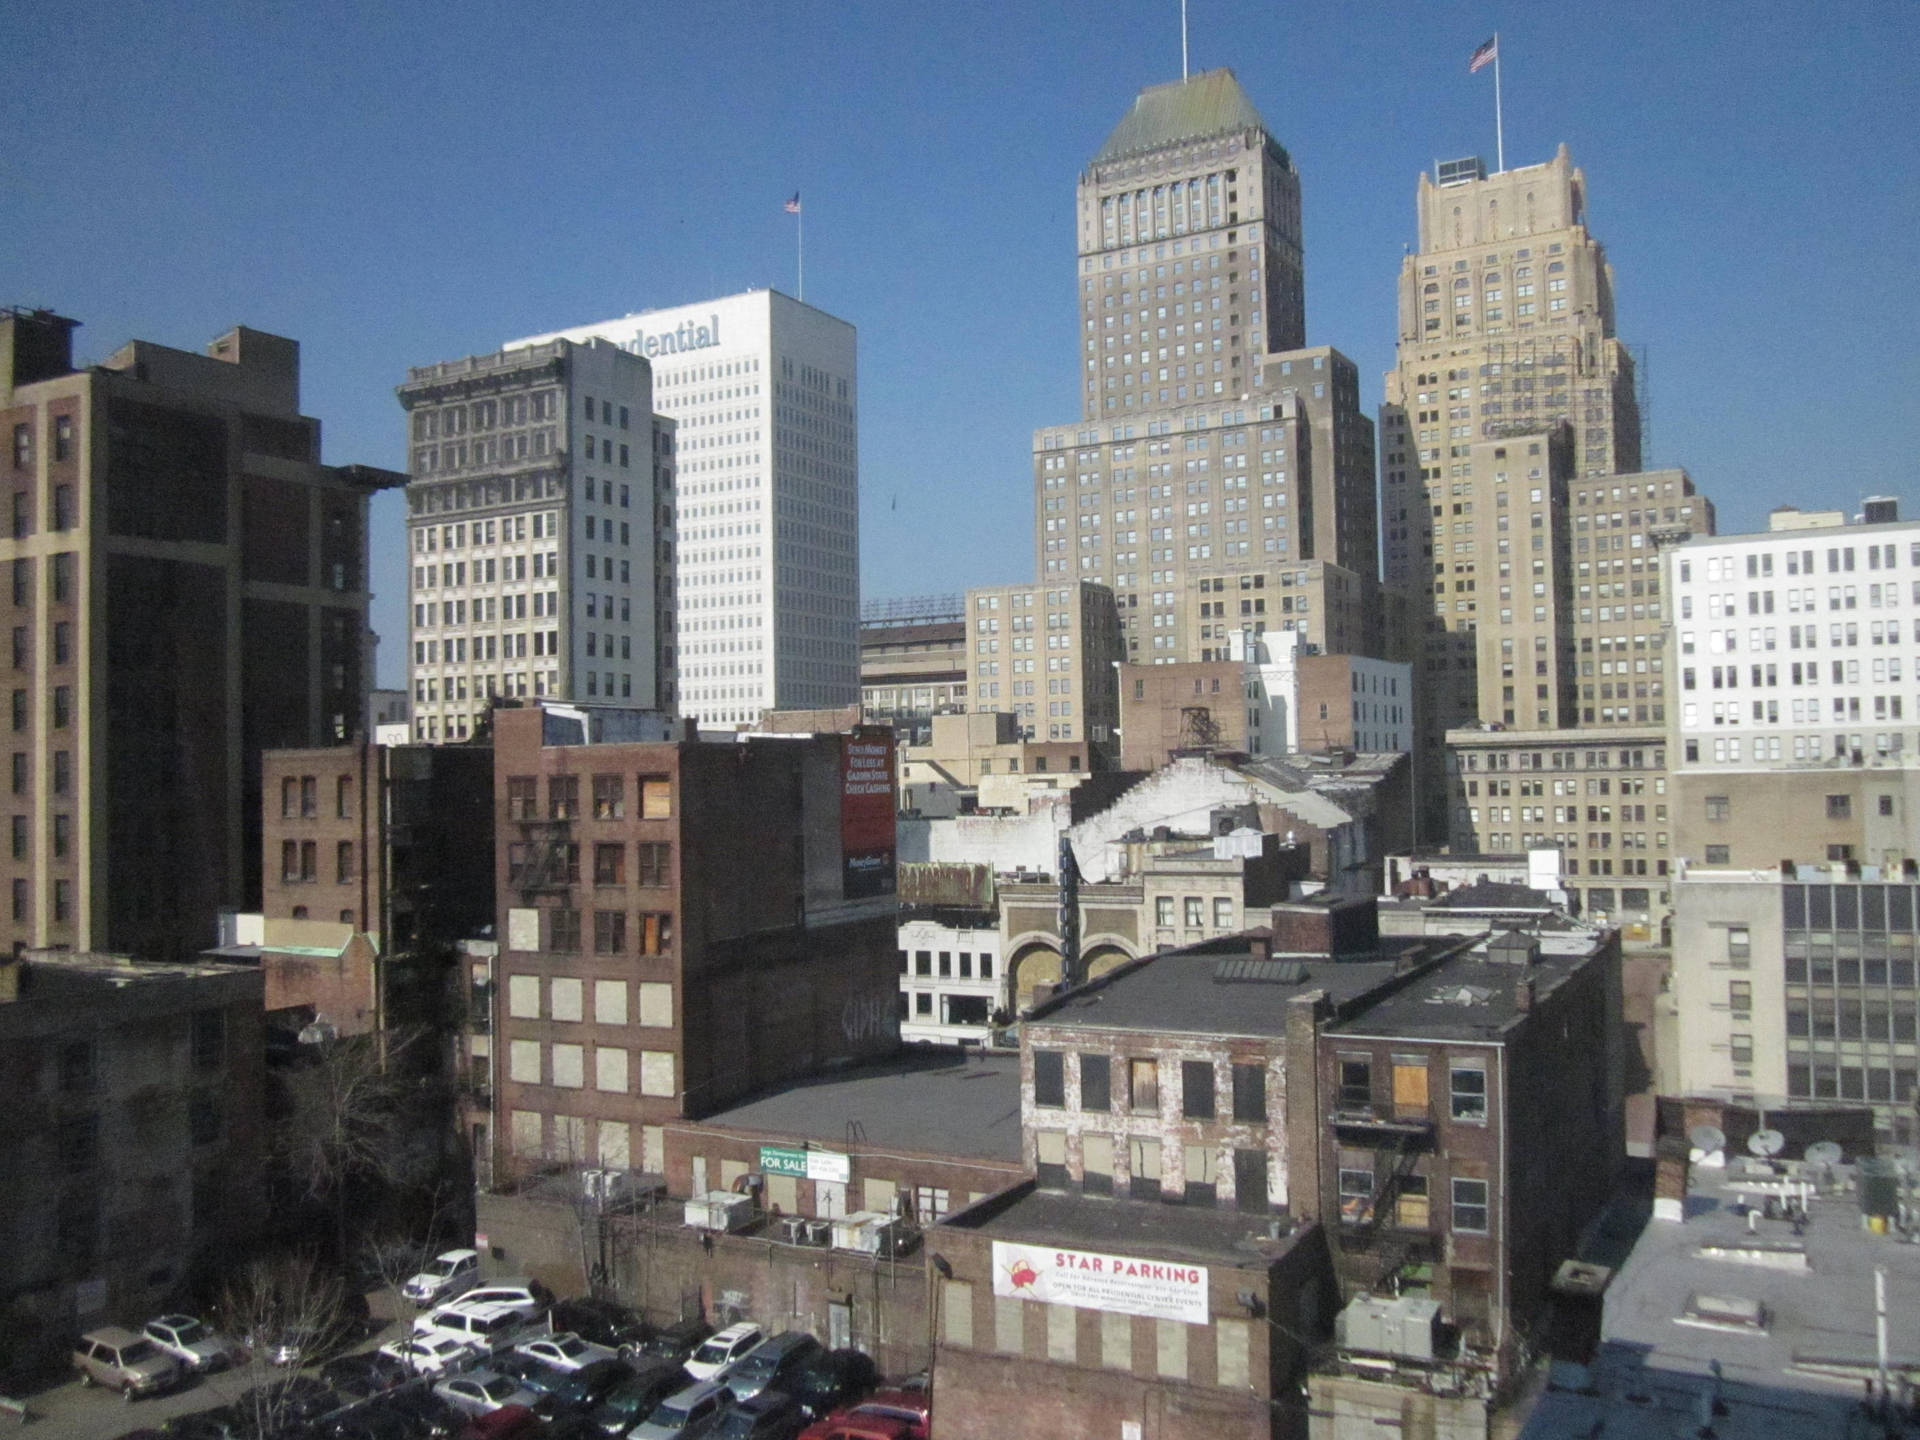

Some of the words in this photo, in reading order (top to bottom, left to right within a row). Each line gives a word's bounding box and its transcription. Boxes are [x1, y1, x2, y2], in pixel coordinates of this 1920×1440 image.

[864, 743, 887, 754] MONEY
[850, 756, 862, 768] FOR
[862, 757, 876, 768] LESS
[871, 769, 888, 780] STATE
[845, 782, 864, 794] CHECK
[865, 782, 891, 793] CASHING
[761, 1156, 781, 1168] FOR
[784, 1159, 807, 1171] SALE
[1056, 1253, 1103, 1272] STAR
[1113, 1260, 1200, 1284] PARKING
[1052, 1281, 1072, 1291] OPEN
[1073, 1284, 1086, 1293] FOR
[1089, 1286, 1101, 1294] ALL
[1102, 1288, 1145, 1300] PRUDENTIAL
[1147, 1293, 1174, 1304] CENTER
[1176, 1298, 1203, 1307] EVENTS
